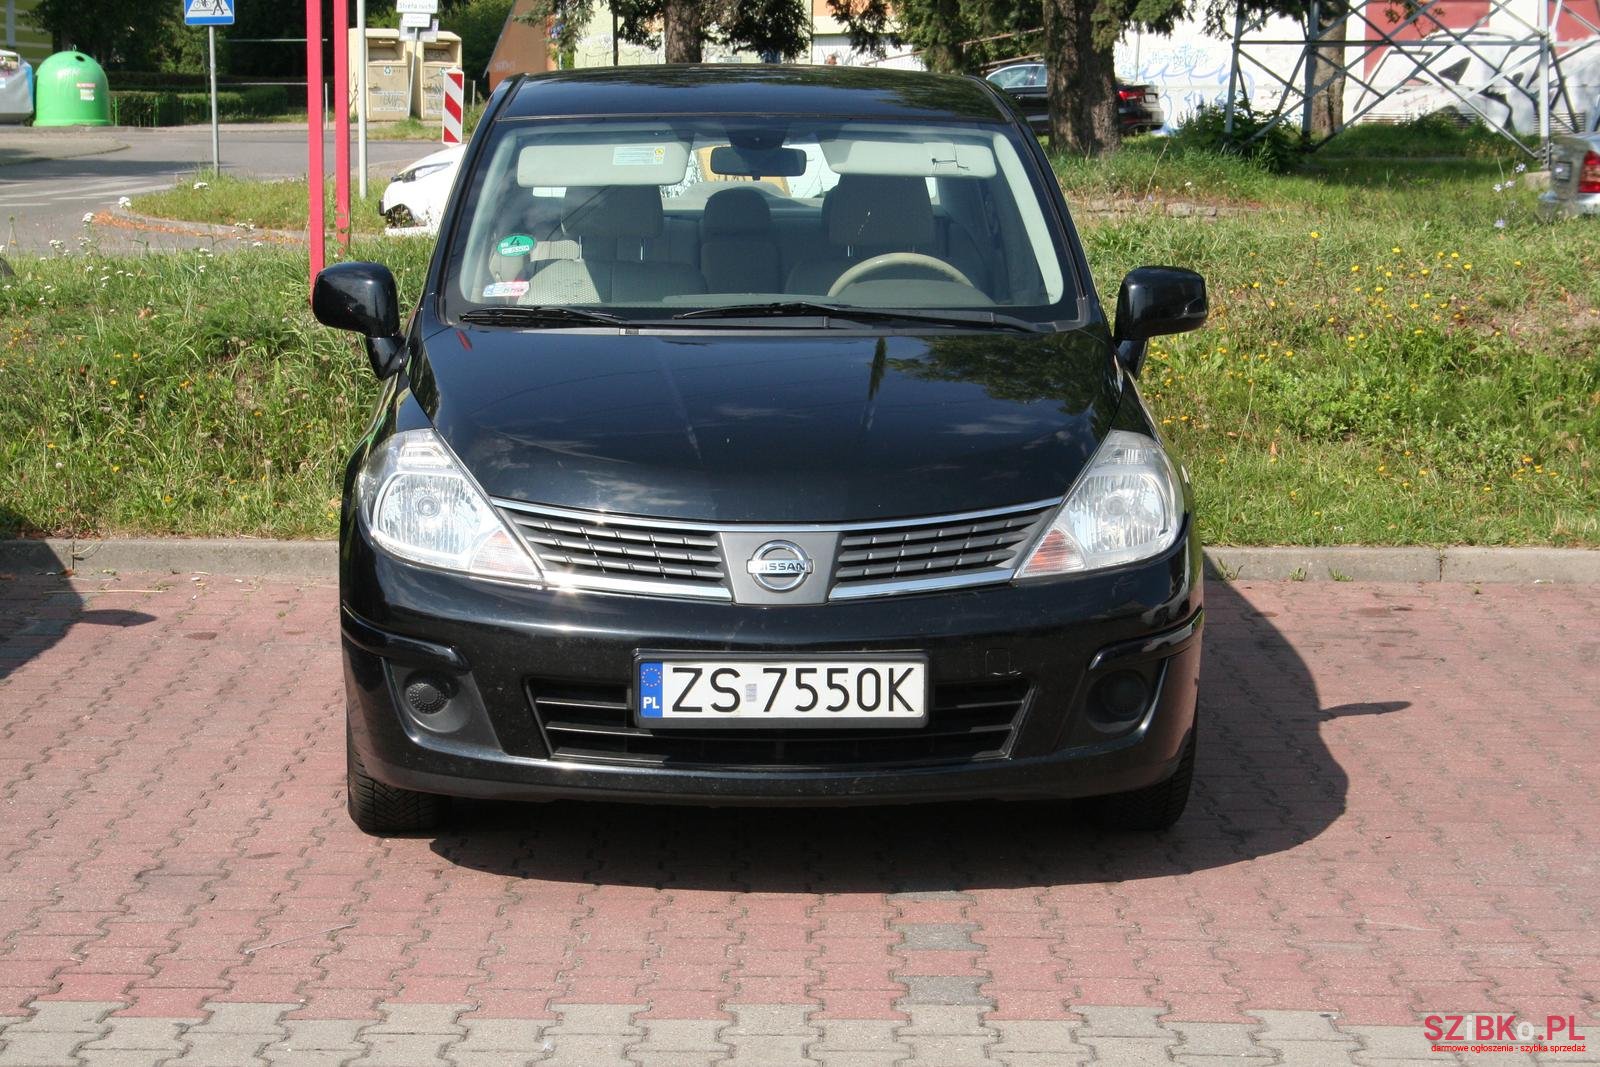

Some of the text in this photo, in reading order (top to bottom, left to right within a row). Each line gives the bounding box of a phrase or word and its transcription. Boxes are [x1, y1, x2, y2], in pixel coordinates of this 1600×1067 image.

[642, 696, 660, 710] PL
[672, 667, 914, 713] ZS 7550K
